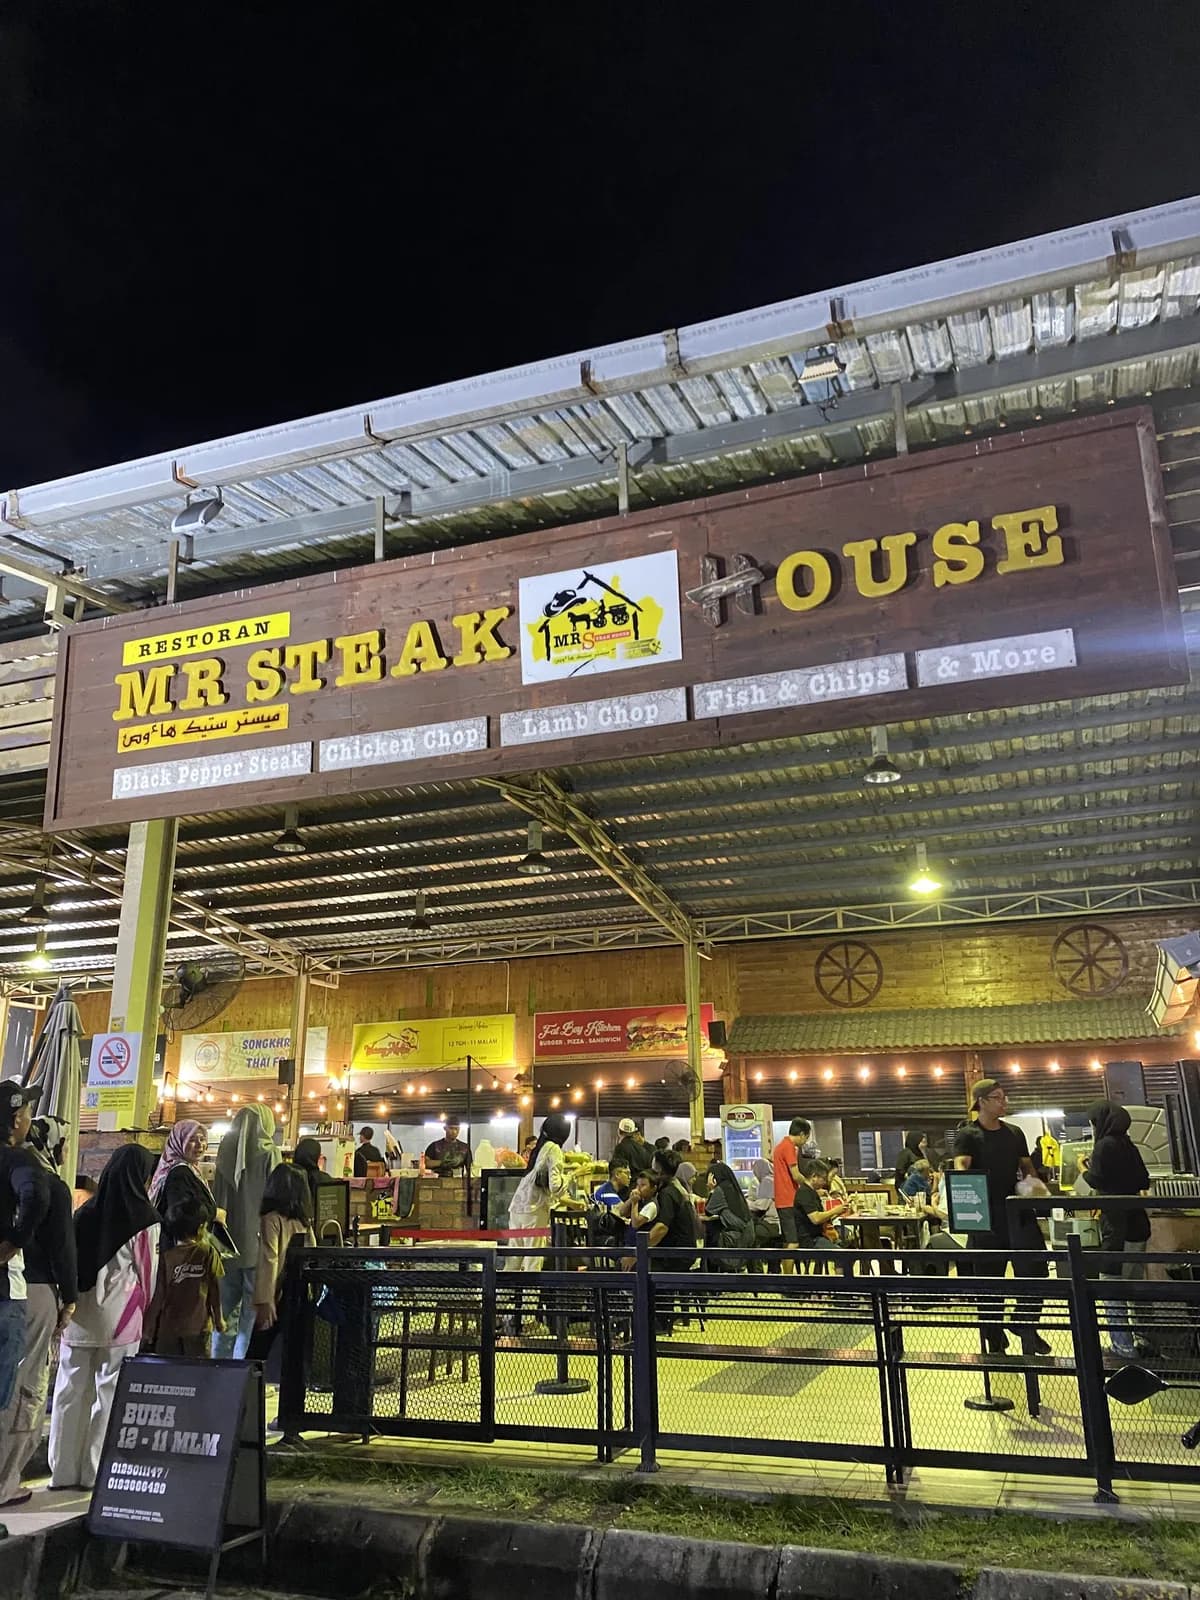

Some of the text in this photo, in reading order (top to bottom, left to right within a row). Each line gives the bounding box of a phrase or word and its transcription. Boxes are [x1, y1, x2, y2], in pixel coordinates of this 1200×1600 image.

[138, 621, 271, 657] RESTORAN
[553, 632, 582, 649] MR
[112, 657, 226, 721] MR
[246, 606, 512, 703] STEAK
[936, 644, 1057, 679] & More
[704, 668, 891, 711] Fish & Chips
[522, 703, 659, 737] Lamb Chop
[326, 728, 479, 762] Chicken Chop
[120, 752, 304, 792] Black Pepper Steak
[242, 1037, 291, 1050] SONGKHR
[538, 1020, 621, 1040] Fat Boy Kitchen
[588, 1036, 621, 1044] SANDWICH
[246, 1057, 270, 1069] THAI
[128, 1383, 196, 1397] MR STEAKHOUSE
[122, 1402, 176, 1428] BUKA
[117, 1427, 221, 1457] 12 - 11 MLM
